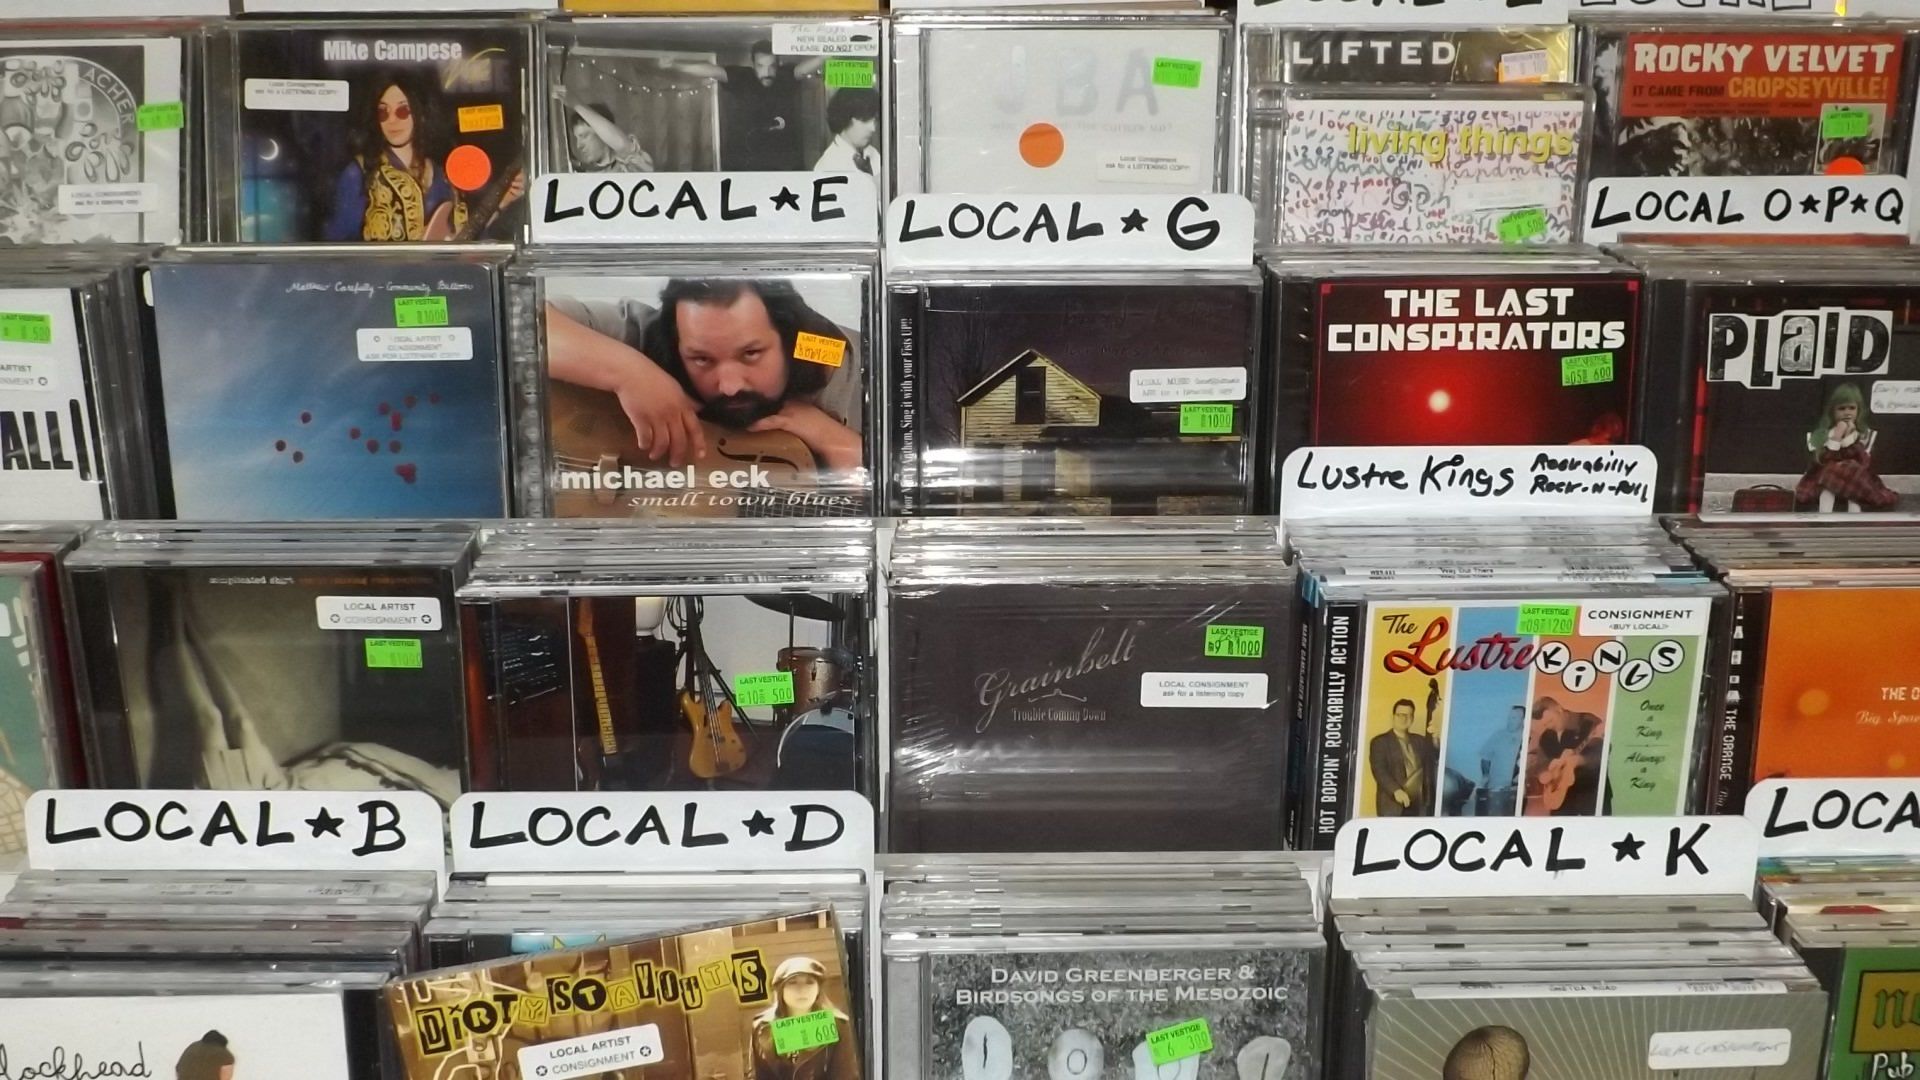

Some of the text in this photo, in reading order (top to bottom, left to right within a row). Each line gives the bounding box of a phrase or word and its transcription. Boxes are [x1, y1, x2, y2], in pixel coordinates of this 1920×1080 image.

[324, 40, 462, 62] Mike Campese
[1293, 41, 1458, 65] LIFTED
[1634, 43, 1895, 73] ROCKY VELVET
[1633, 76, 1888, 99] IT CAME FROM CROPSEYVILLE!
[1348, 124, 1573, 164] living things
[544, 176, 848, 224] LOCAL E
[1591, 185, 1744, 228] LOCAL
[899, 197, 1220, 250] LOCAL G
[1384, 288, 1574, 318] THE LAST
[1328, 321, 1625, 351] CONSPIRATORS
[900, 338, 913, 357] Fists
[902, 358, 916, 379] your
[900, 380, 913, 399] with
[900, 400, 913, 408] it
[900, 408, 916, 429] Sing
[1297, 451, 1515, 496] Lustre Kings
[1530, 450, 1638, 476] Rockabilly
[562, 465, 769, 490] michael eck
[628, 491, 852, 508] small town blues
[344, 616, 417, 624] CONSIGNMENT
[1522, 608, 1540, 616] LAST
[1588, 609, 1694, 620] CONSIGNMENT
[1382, 614, 1419, 634] The
[1236, 638, 1260, 655] 1000
[1384, 615, 1541, 676] Lustre
[739, 675, 788, 684] LAST VESTIGE
[974, 626, 1137, 733] Grainbelt
[772, 688, 792, 702] 500
[1881, 686, 1907, 701] THE
[1012, 707, 1106, 722] Trouble Coming Down
[1640, 700, 1664, 712] Once
[1319, 616, 1350, 834] HOT BOPPIN' ROCKABILLY ACTION
[1637, 726, 1662, 740] King
[1719, 709, 1738, 781] THE ORANGE
[1624, 752, 1666, 765] Always
[1630, 777, 1656, 792] King
[45, 798, 406, 856] LOCAL B
[470, 801, 845, 851] LOCAL D
[1353, 823, 1711, 876] LOCAL K
[1238, 965, 1255, 981] &
[776, 1012, 827, 1029] LAST VESTIGE
[1151, 1023, 1201, 1044] LAST VESTIGE
[550, 1035, 631, 1060] LOCAL ARTIST
[552, 1051, 636, 1075] CONSIGNMENT
[1871, 1051, 1914, 1080] Pub
